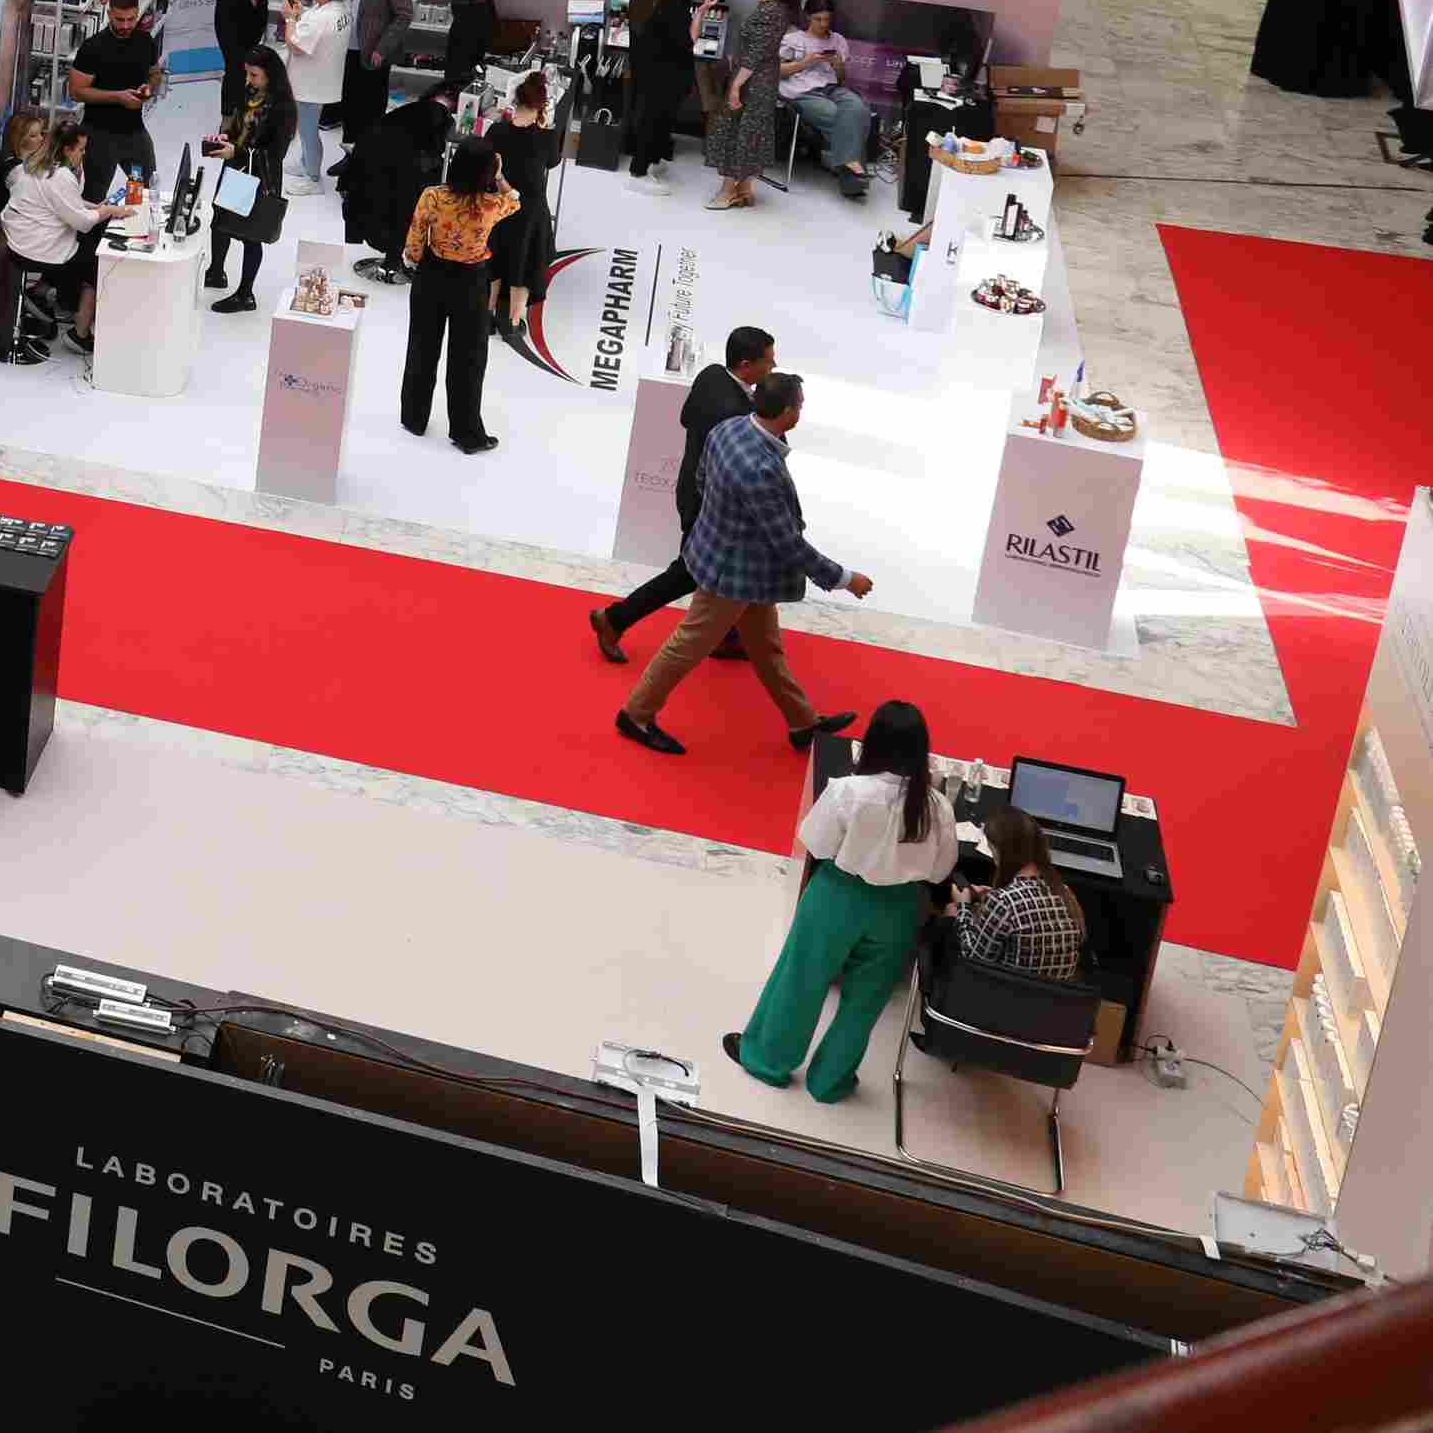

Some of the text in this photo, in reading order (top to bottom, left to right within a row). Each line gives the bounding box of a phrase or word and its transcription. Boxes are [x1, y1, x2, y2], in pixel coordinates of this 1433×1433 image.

[590, 248, 638, 392] MEGAPHARM
[1006, 532, 1102, 571] RILASTIL
[75, 1146, 439, 1268] LABORATOIRES
[319, 1357, 418, 1403] PARIS
